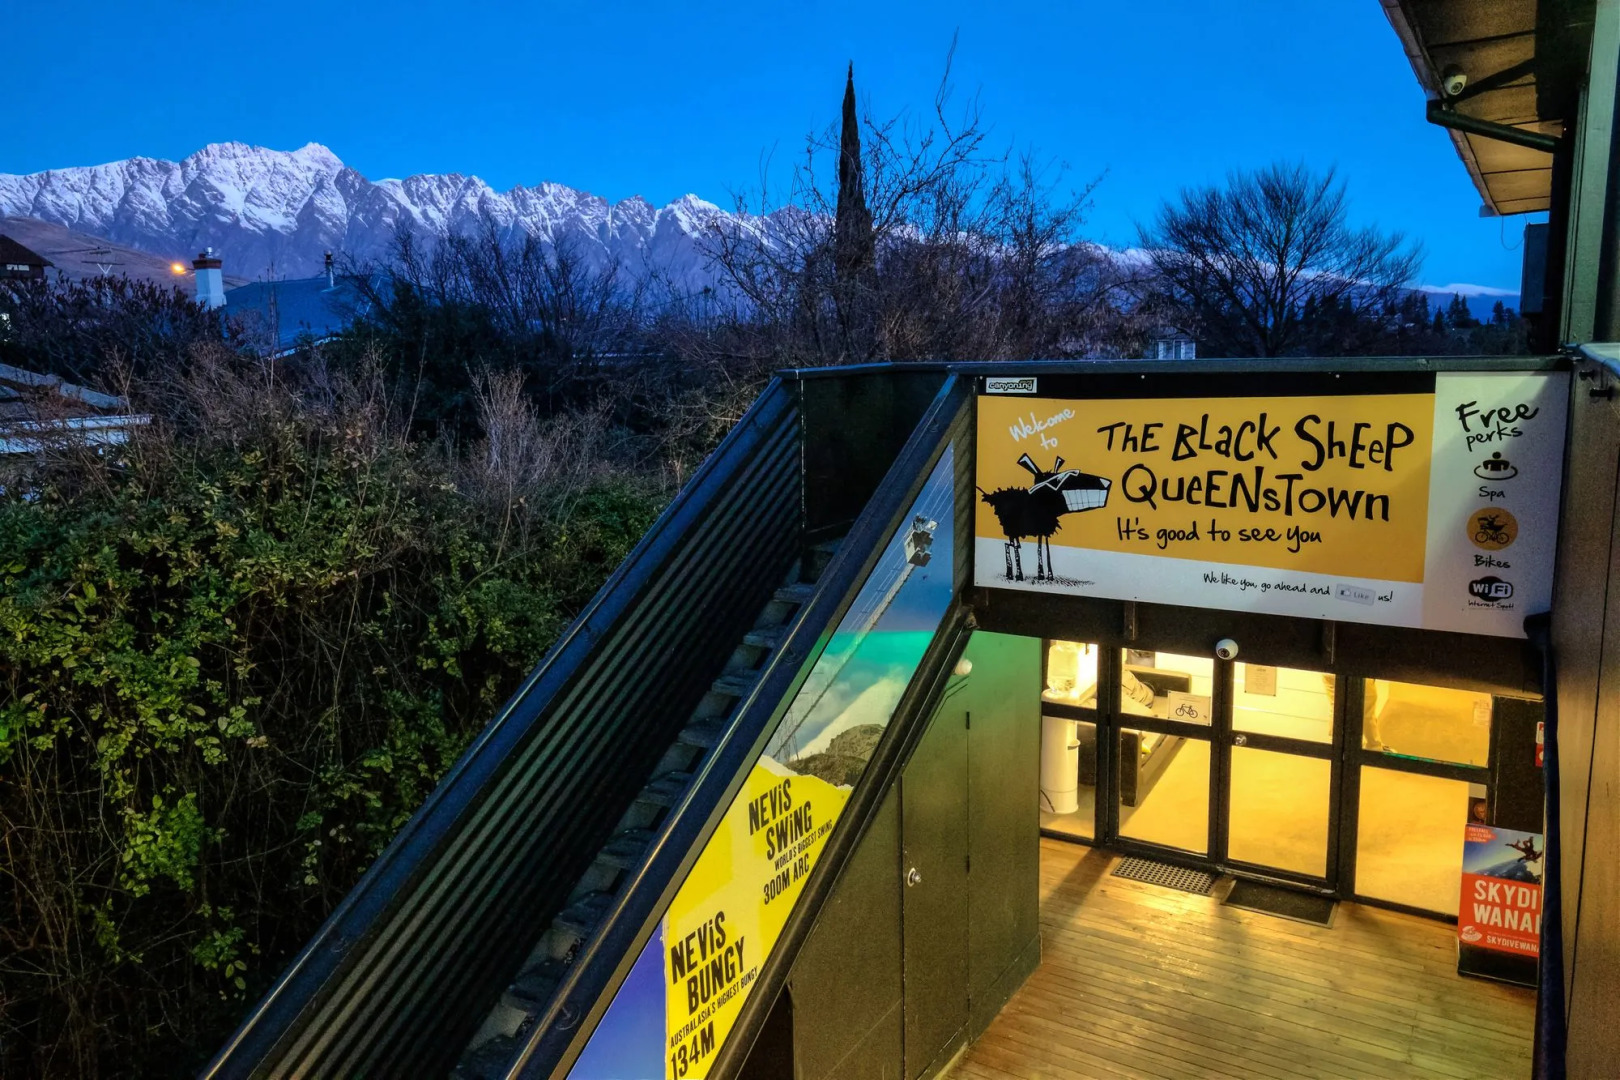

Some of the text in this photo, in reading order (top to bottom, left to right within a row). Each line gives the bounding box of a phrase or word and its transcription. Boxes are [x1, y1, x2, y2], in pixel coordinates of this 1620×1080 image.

[1009, 408, 1075, 442] Welcome
[1455, 401, 1539, 432] Free
[1040, 433, 1059, 450] to
[1466, 420, 1523, 452] perks
[1479, 486, 1506, 501] Spa
[1117, 517, 1322, 553] It's good to see you
[1474, 554, 1511, 568] Bikes
[1203, 571, 1219, 584] We
[1221, 572, 1238, 585] like
[1240, 577, 1257, 591] you,
[1261, 583, 1271, 592] go
[1274, 581, 1307, 593] ahead
[1310, 584, 1331, 595] and
[1378, 591, 1394, 602] us!
[774, 846, 797, 871] WORLD'S
[763, 852, 810, 905] 300M ARC
[1474, 880, 1541, 909] SKYDI
[687, 936, 745, 1016] BUNGY
[740, 965, 758, 989] BUNGY
[670, 1020, 716, 1080] 134M
